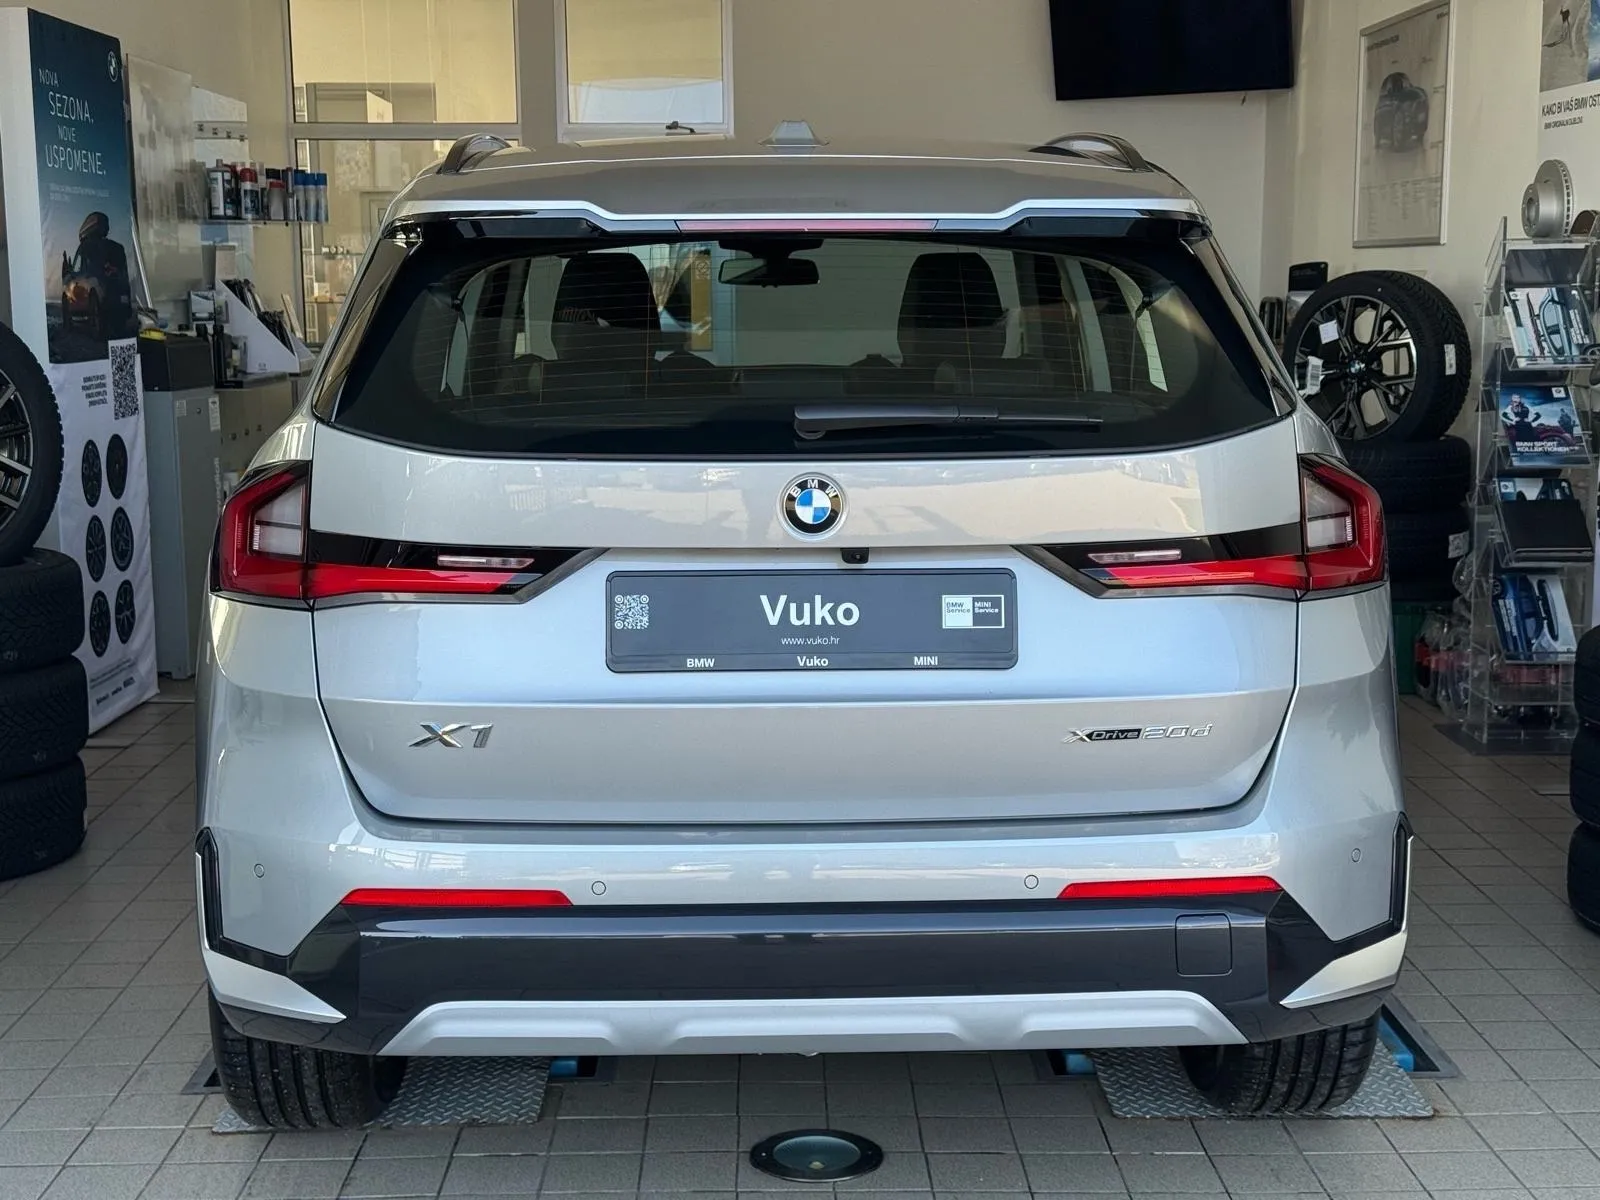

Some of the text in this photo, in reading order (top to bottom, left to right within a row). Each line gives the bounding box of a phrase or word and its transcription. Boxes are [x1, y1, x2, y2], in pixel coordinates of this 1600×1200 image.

[39, 68, 60, 87] NOVA
[49, 91, 94, 123] SEZONA,
[1542, 102, 1556, 116] KAKO
[1557, 101, 1562, 114] BI
[1574, 96, 1588, 110] BMW
[58, 125, 76, 142] NOVE
[790, 479, 837, 498] BMW
[760, 594, 860, 626] Vuko
[781, 636, 840, 645] www.vuko.hr
[686, 656, 938, 668] BMW Vuko MINI
[408, 721, 493, 748] X1
